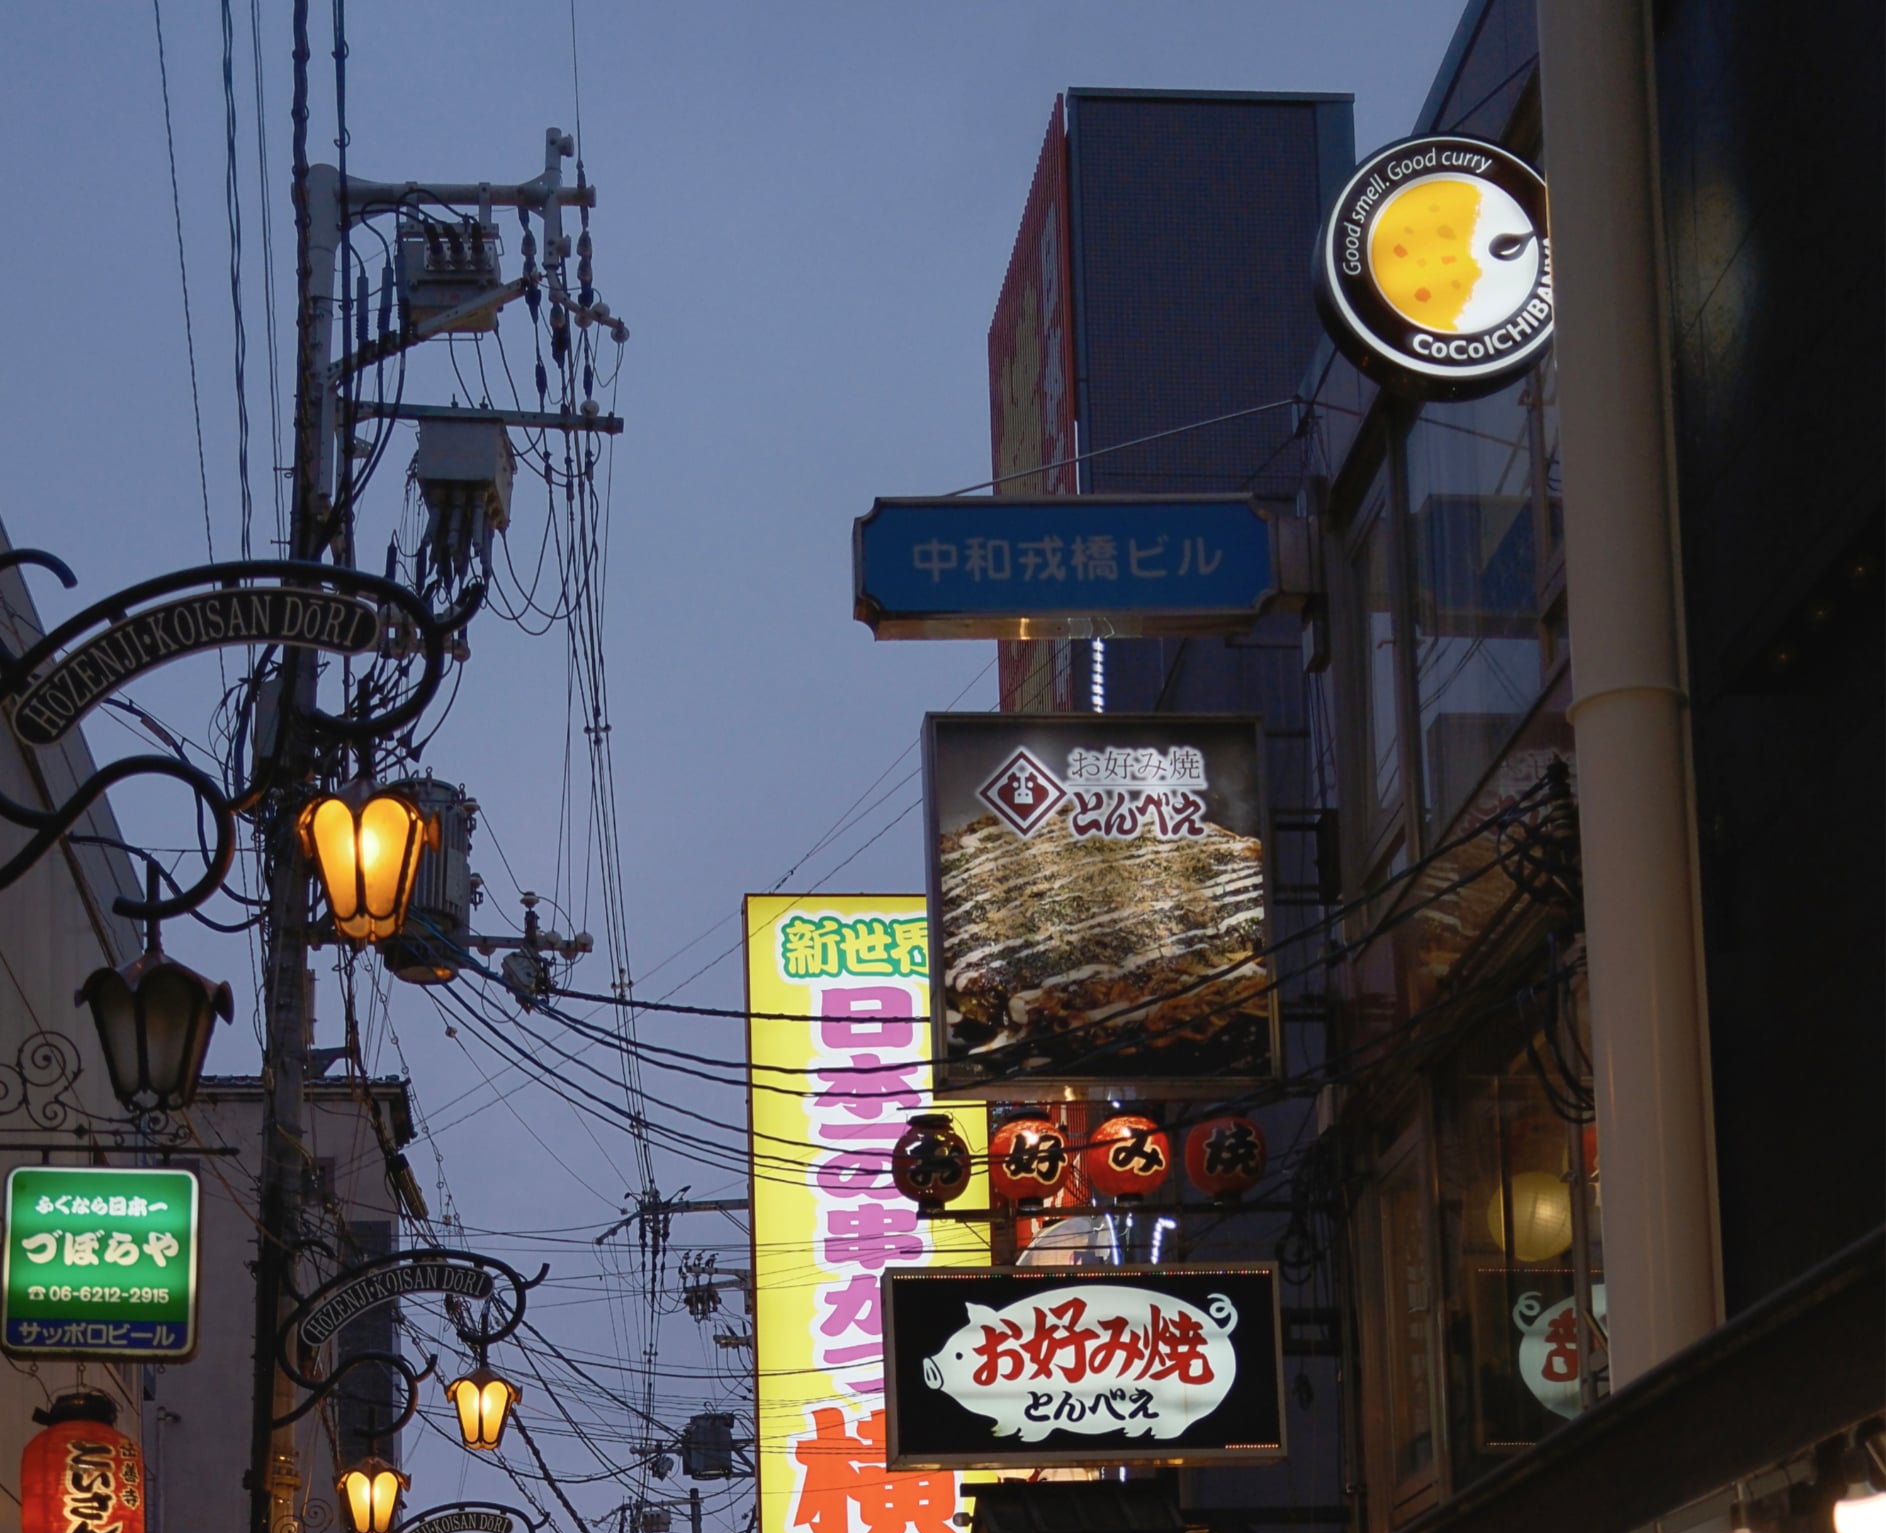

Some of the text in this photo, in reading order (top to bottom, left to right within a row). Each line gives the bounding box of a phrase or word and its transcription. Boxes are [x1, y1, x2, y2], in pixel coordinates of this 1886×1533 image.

[1343, 148, 1493, 276] Good smell. Good curry
[1412, 237, 1554, 360] CoCoICHIBA
[912, 535, 1223, 583] 中和戎橋ビル
[1071, 750, 1201, 779] お好み焼
[1071, 790, 1205, 836] とんべえ
[784, 914, 929, 979] 新世界
[35, 1195, 168, 1217] ふぐなら日本一
[21, 1230, 179, 1268] づぼらや
[49, 1286, 170, 1304] 06-6212-2915
[19, 1323, 175, 1346] サッポロビール
[972, 1297, 1216, 1386] お好み焼
[1023, 1387, 1160, 1423] とんべえ
